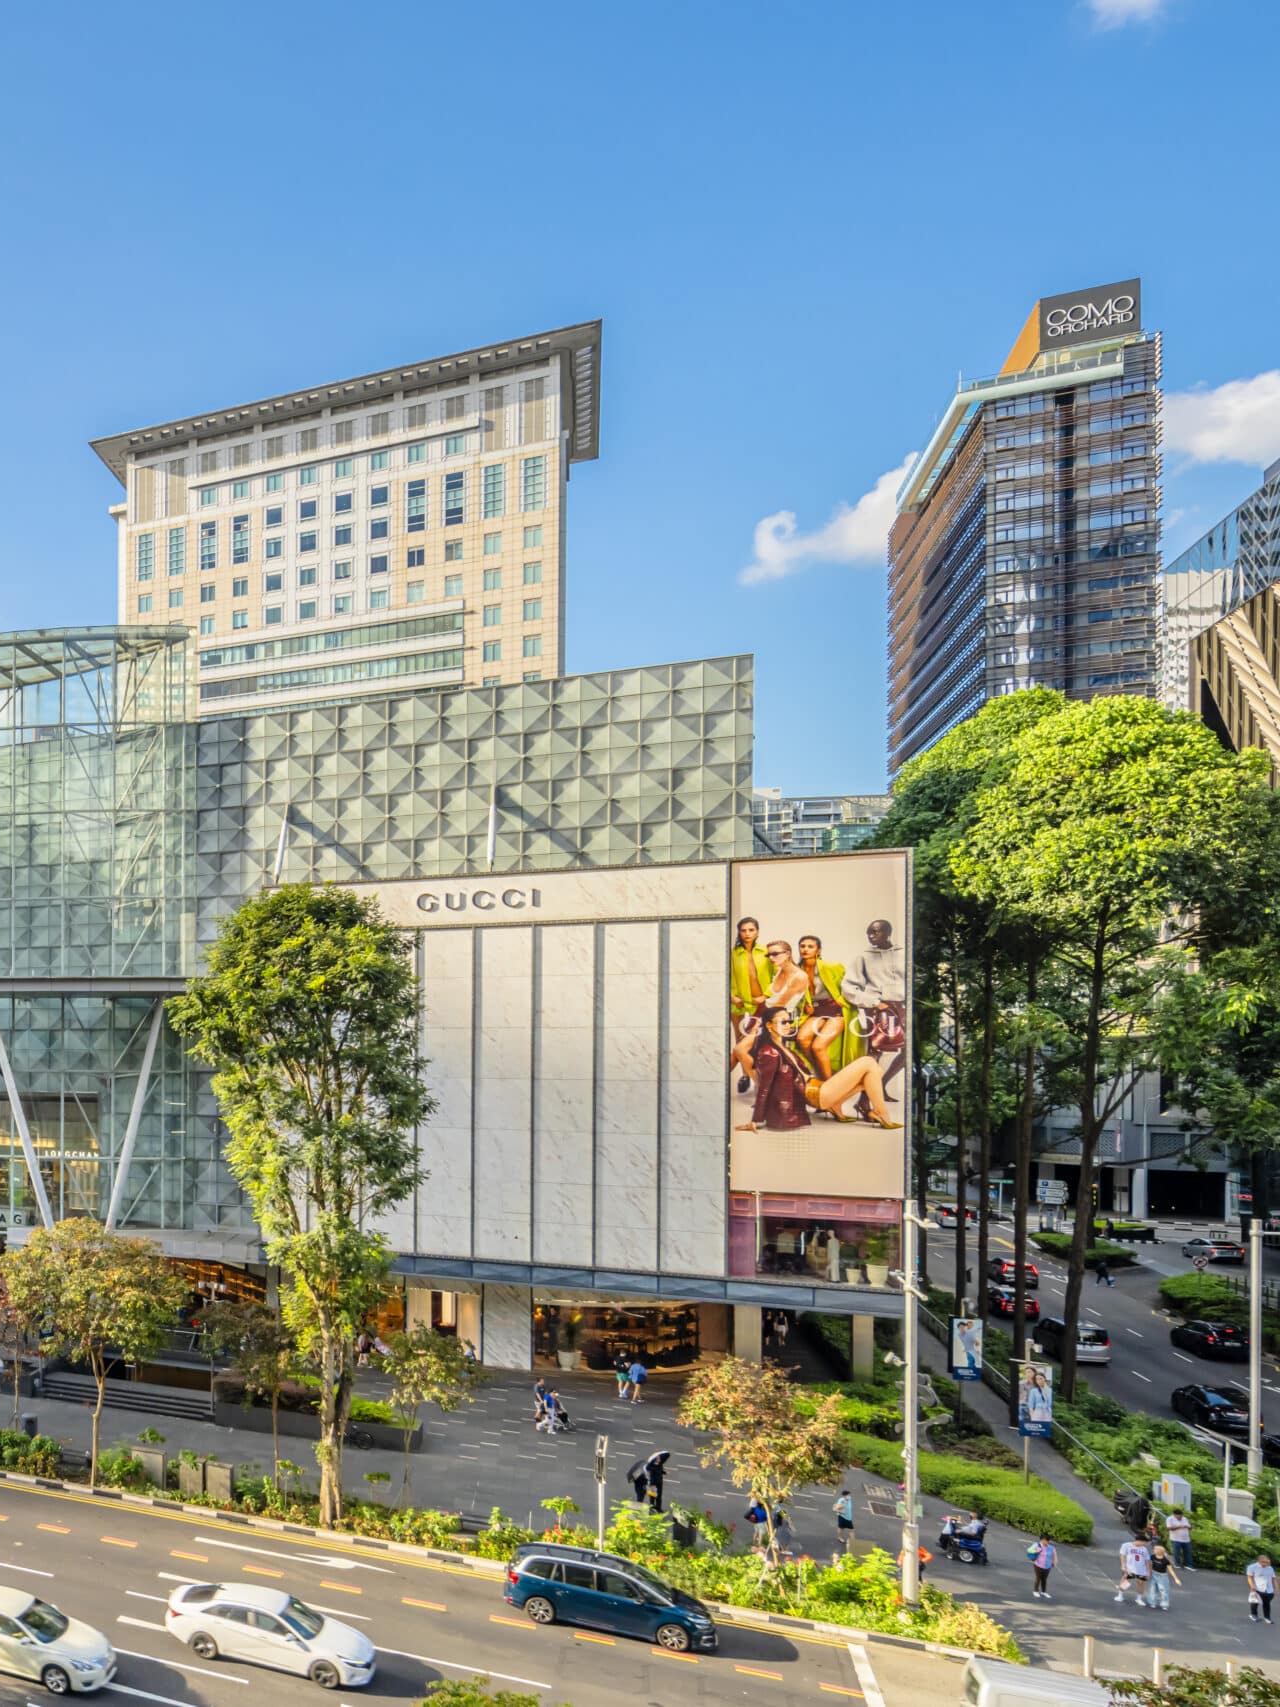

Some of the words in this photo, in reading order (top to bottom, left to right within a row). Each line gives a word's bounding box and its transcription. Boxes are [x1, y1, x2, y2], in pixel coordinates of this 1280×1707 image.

[1047, 295, 1134, 326] COMO
[1047, 312, 1133, 337] ORCHARD
[417, 888, 541, 913] GUCCI
[739, 1011, 896, 1038] GUCCI
